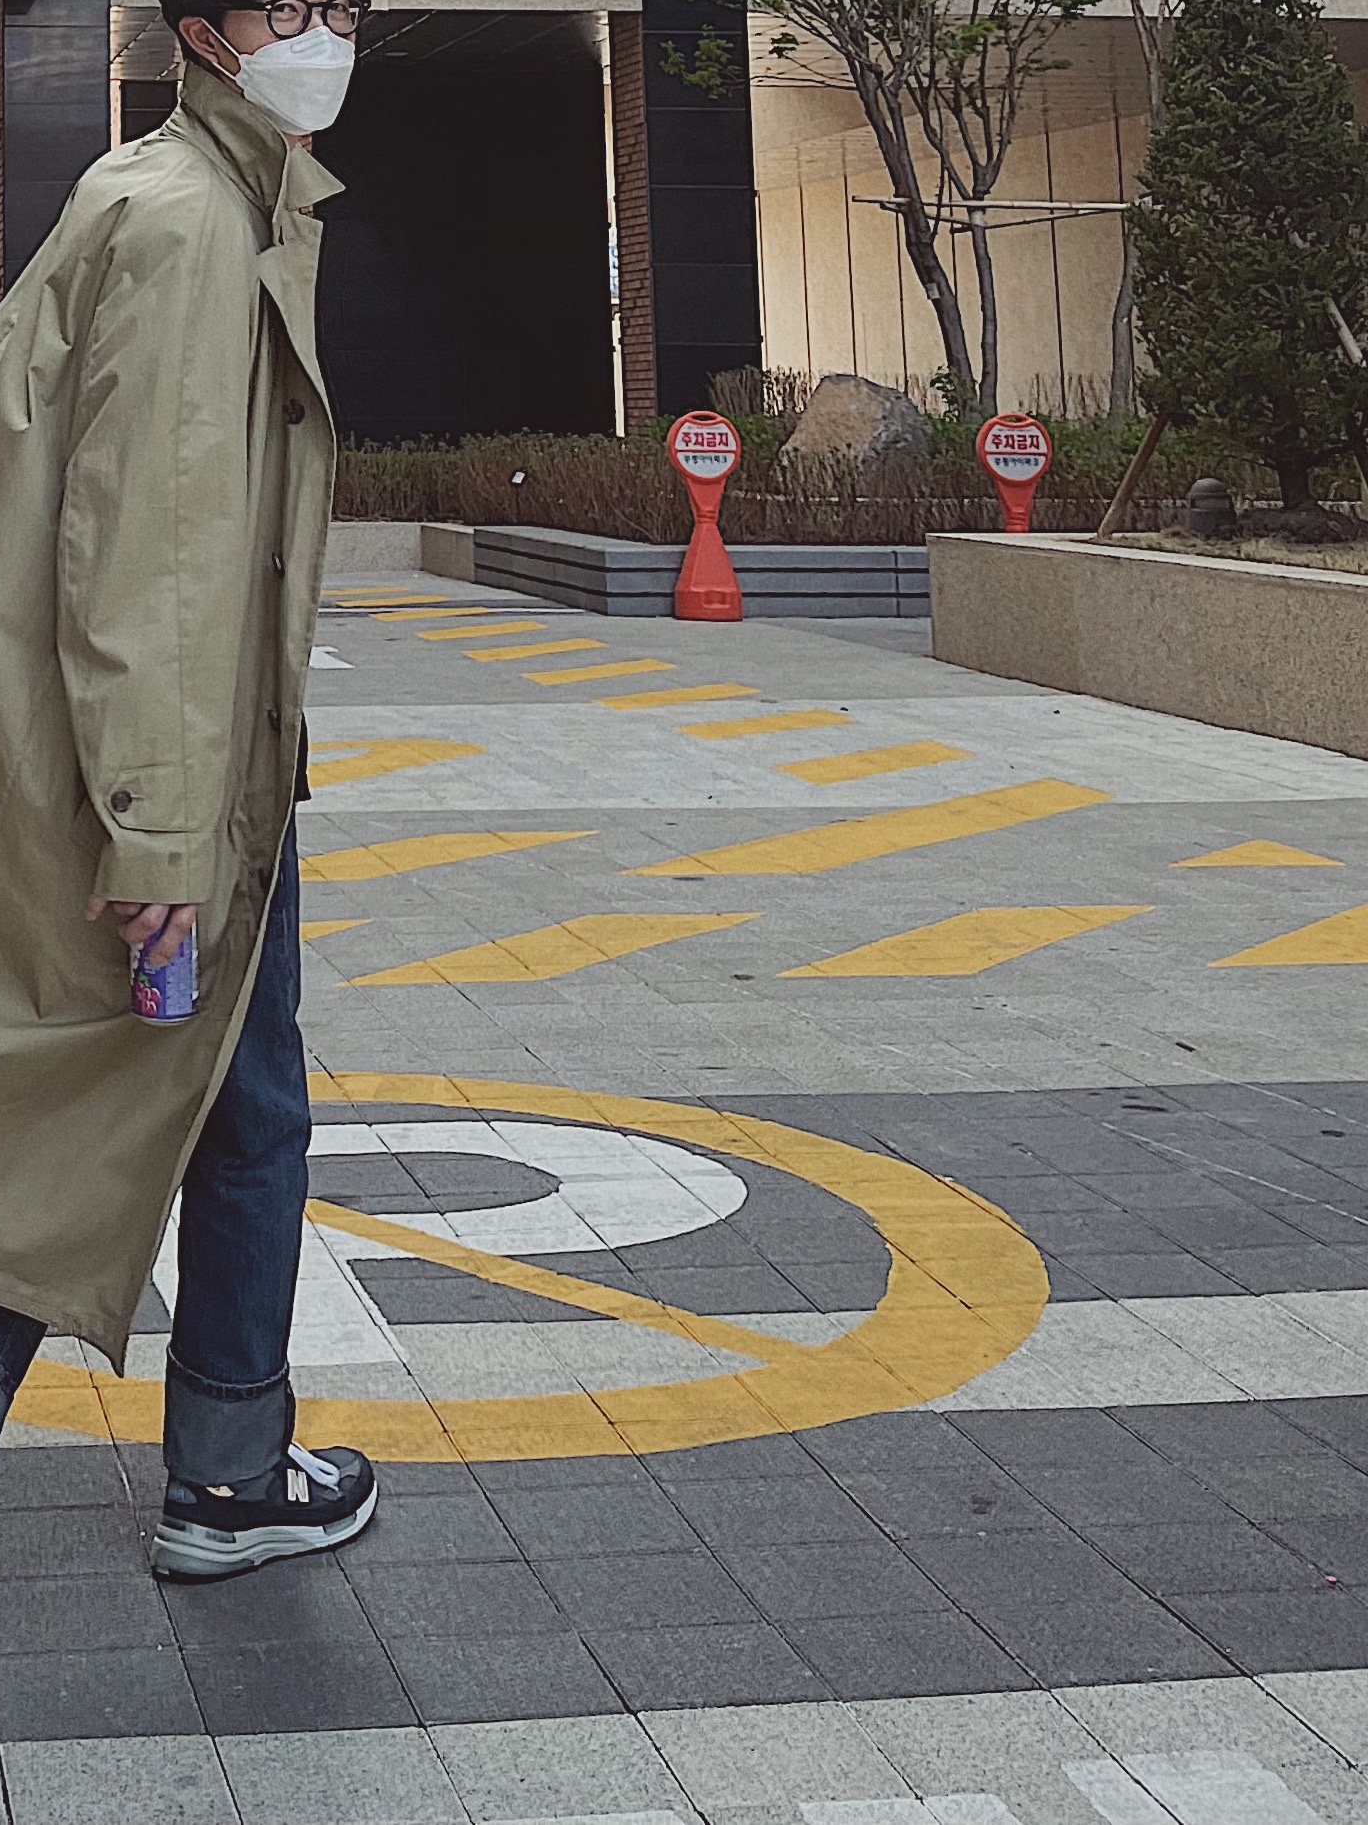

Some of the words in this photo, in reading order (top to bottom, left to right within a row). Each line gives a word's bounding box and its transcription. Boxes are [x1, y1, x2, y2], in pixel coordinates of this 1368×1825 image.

[681, 431, 729, 448] 주차금지
[992, 434, 1040, 450] 주차금지
[287, 1468, 310, 1503] N
